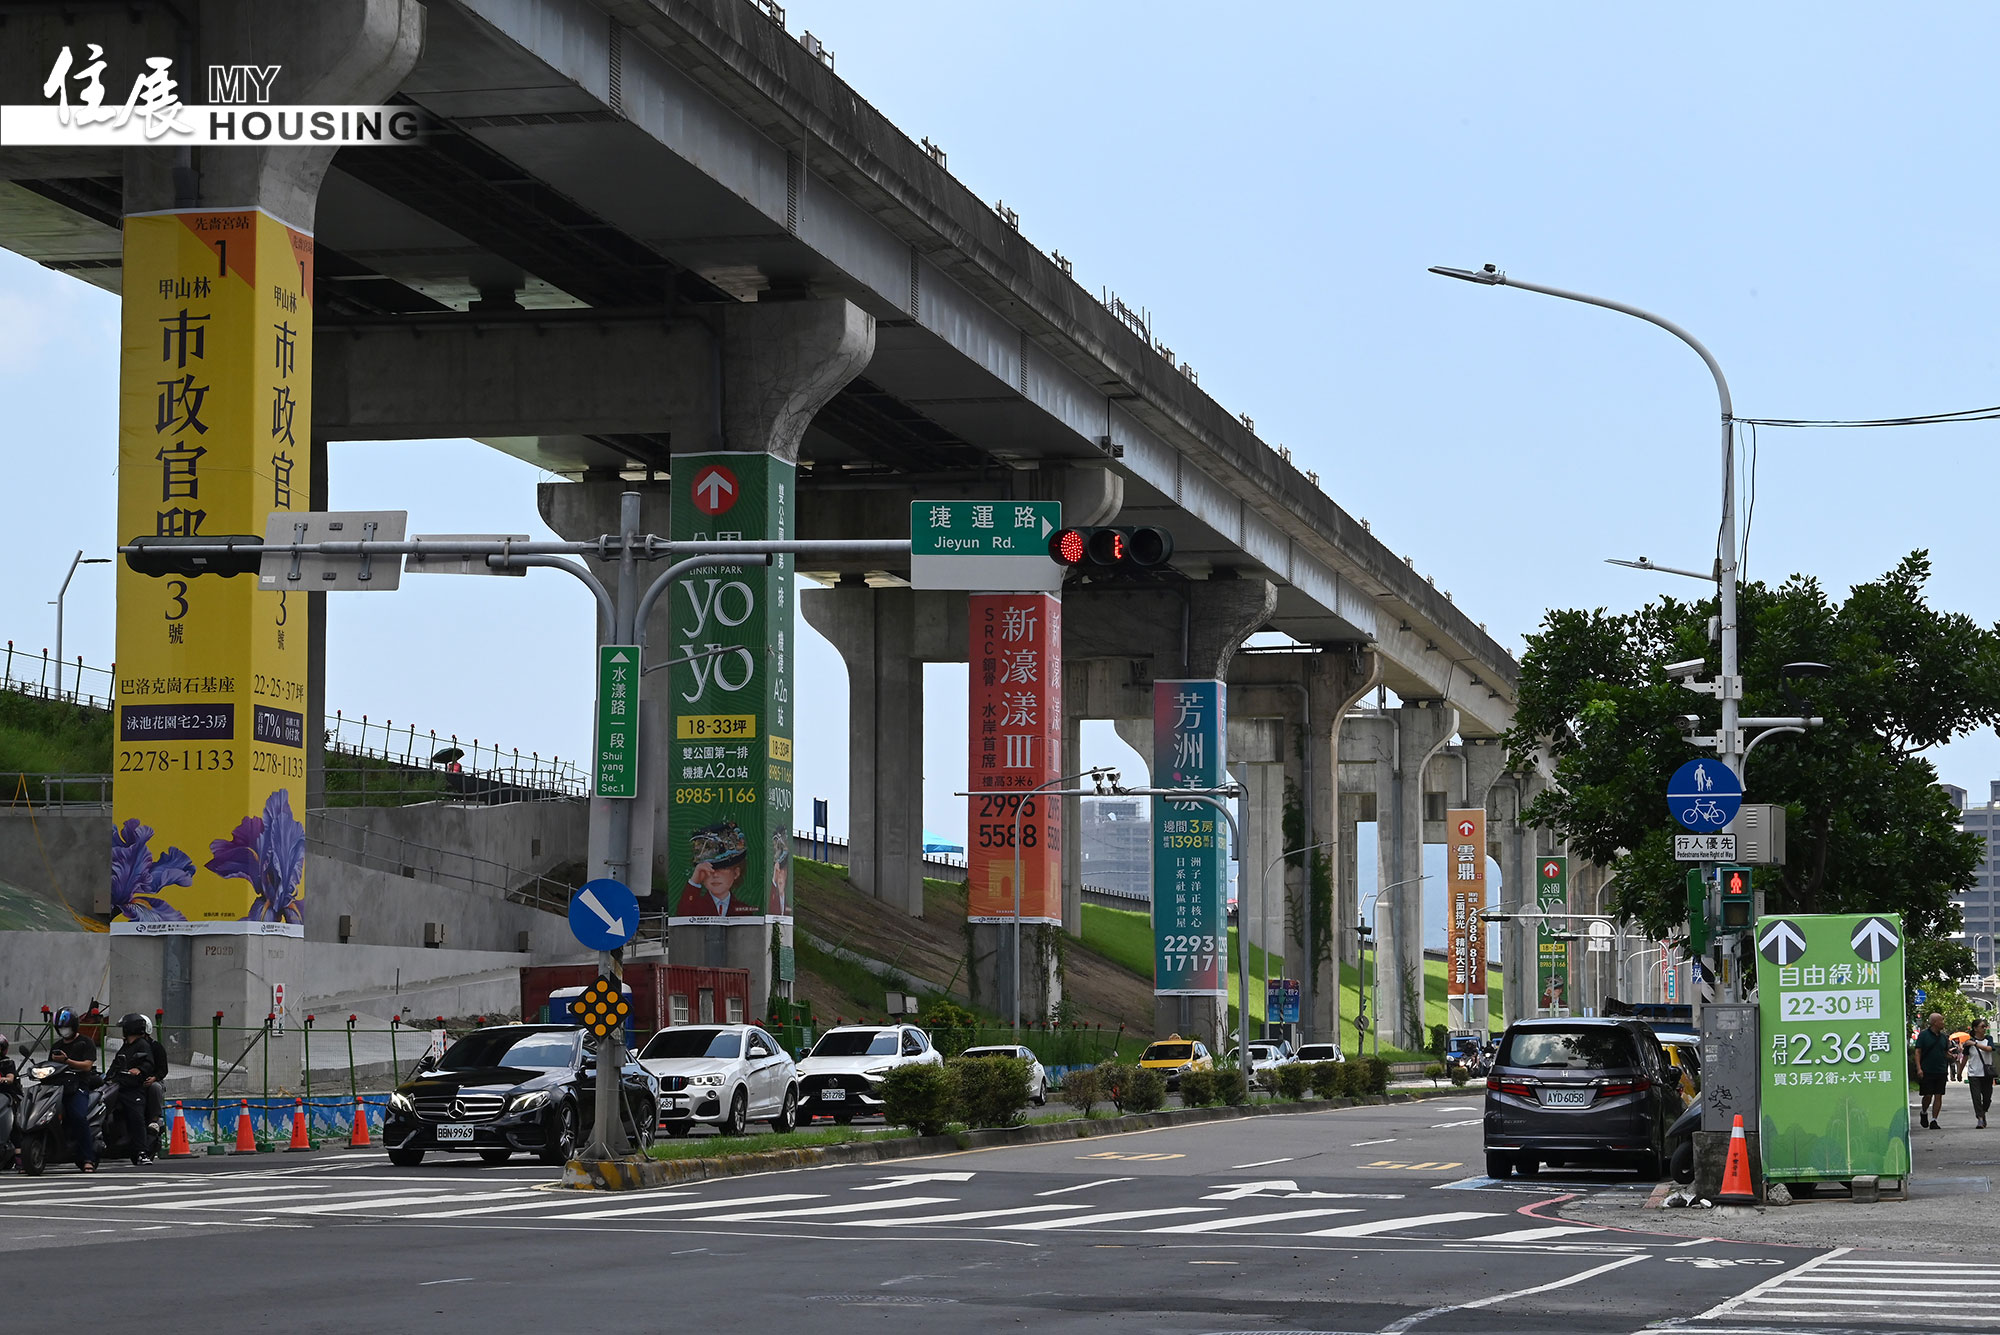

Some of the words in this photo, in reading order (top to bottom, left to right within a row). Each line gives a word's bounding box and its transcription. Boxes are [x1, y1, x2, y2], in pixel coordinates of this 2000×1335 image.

[215, 240, 226, 276] 1
[159, 276, 211, 299] 甲山林
[300, 261, 304, 297] 1
[274, 285, 297, 314] 甲山林
[929, 505, 1037, 529] 捷運路
[934, 536, 980, 551] Jieyun
[992, 536, 1015, 549] Rd.
[720, 566, 743, 574] PARK
[165, 581, 189, 620] 3
[679, 578, 754, 639] yo
[169, 623, 184, 644] 號
[679, 643, 754, 704] yo
[121, 676, 235, 695] 巴洛克崗石基座
[610, 666, 627, 749] 水漾路一段
[126, 714, 227, 731] 泳池花園宅2-3房
[264, 713, 281, 739] 7%
[688, 719, 747, 735] 18-33坪
[120, 750, 234, 772] 2278-1133
[602, 752, 623, 761] Shui
[682, 746, 749, 760] 雙公園第一排
[253, 751, 303, 779] 2278-1133
[601, 764, 624, 773] yang
[601, 774, 617, 782] Rd.
[982, 776, 1033, 787] 樓高3米6
[601, 784, 625, 793] Sec.1
[676, 787, 757, 804] 8985-1166
[979, 824, 1037, 848] 5588
[1163, 820, 1214, 834] 邊間3房
[1170, 835, 1203, 849] 1398
[1677, 837, 1734, 850] 行人優先
[1457, 844, 1475, 881] 雲鼎
[1710, 851, 1720, 859] Right
[1725, 851, 1734, 859] Way
[1175, 857, 1187, 929] 日系社區書屋
[1191, 857, 1203, 929] 洲子洋正核心
[1164, 935, 1215, 953] 2293
[1164, 955, 1214, 972] 1717
[1779, 963, 1880, 986] 自由綠洲
[1788, 996, 1874, 1015] 22-30坪
[1772, 1034, 1788, 1065] 月付
[1790, 1032, 1866, 1065] 2.36
[1867, 1031, 1890, 1052] 萬
[1773, 1070, 1892, 1086] 買3房2衛+大平車
[438, 1128, 473, 1138] BBN-9969
